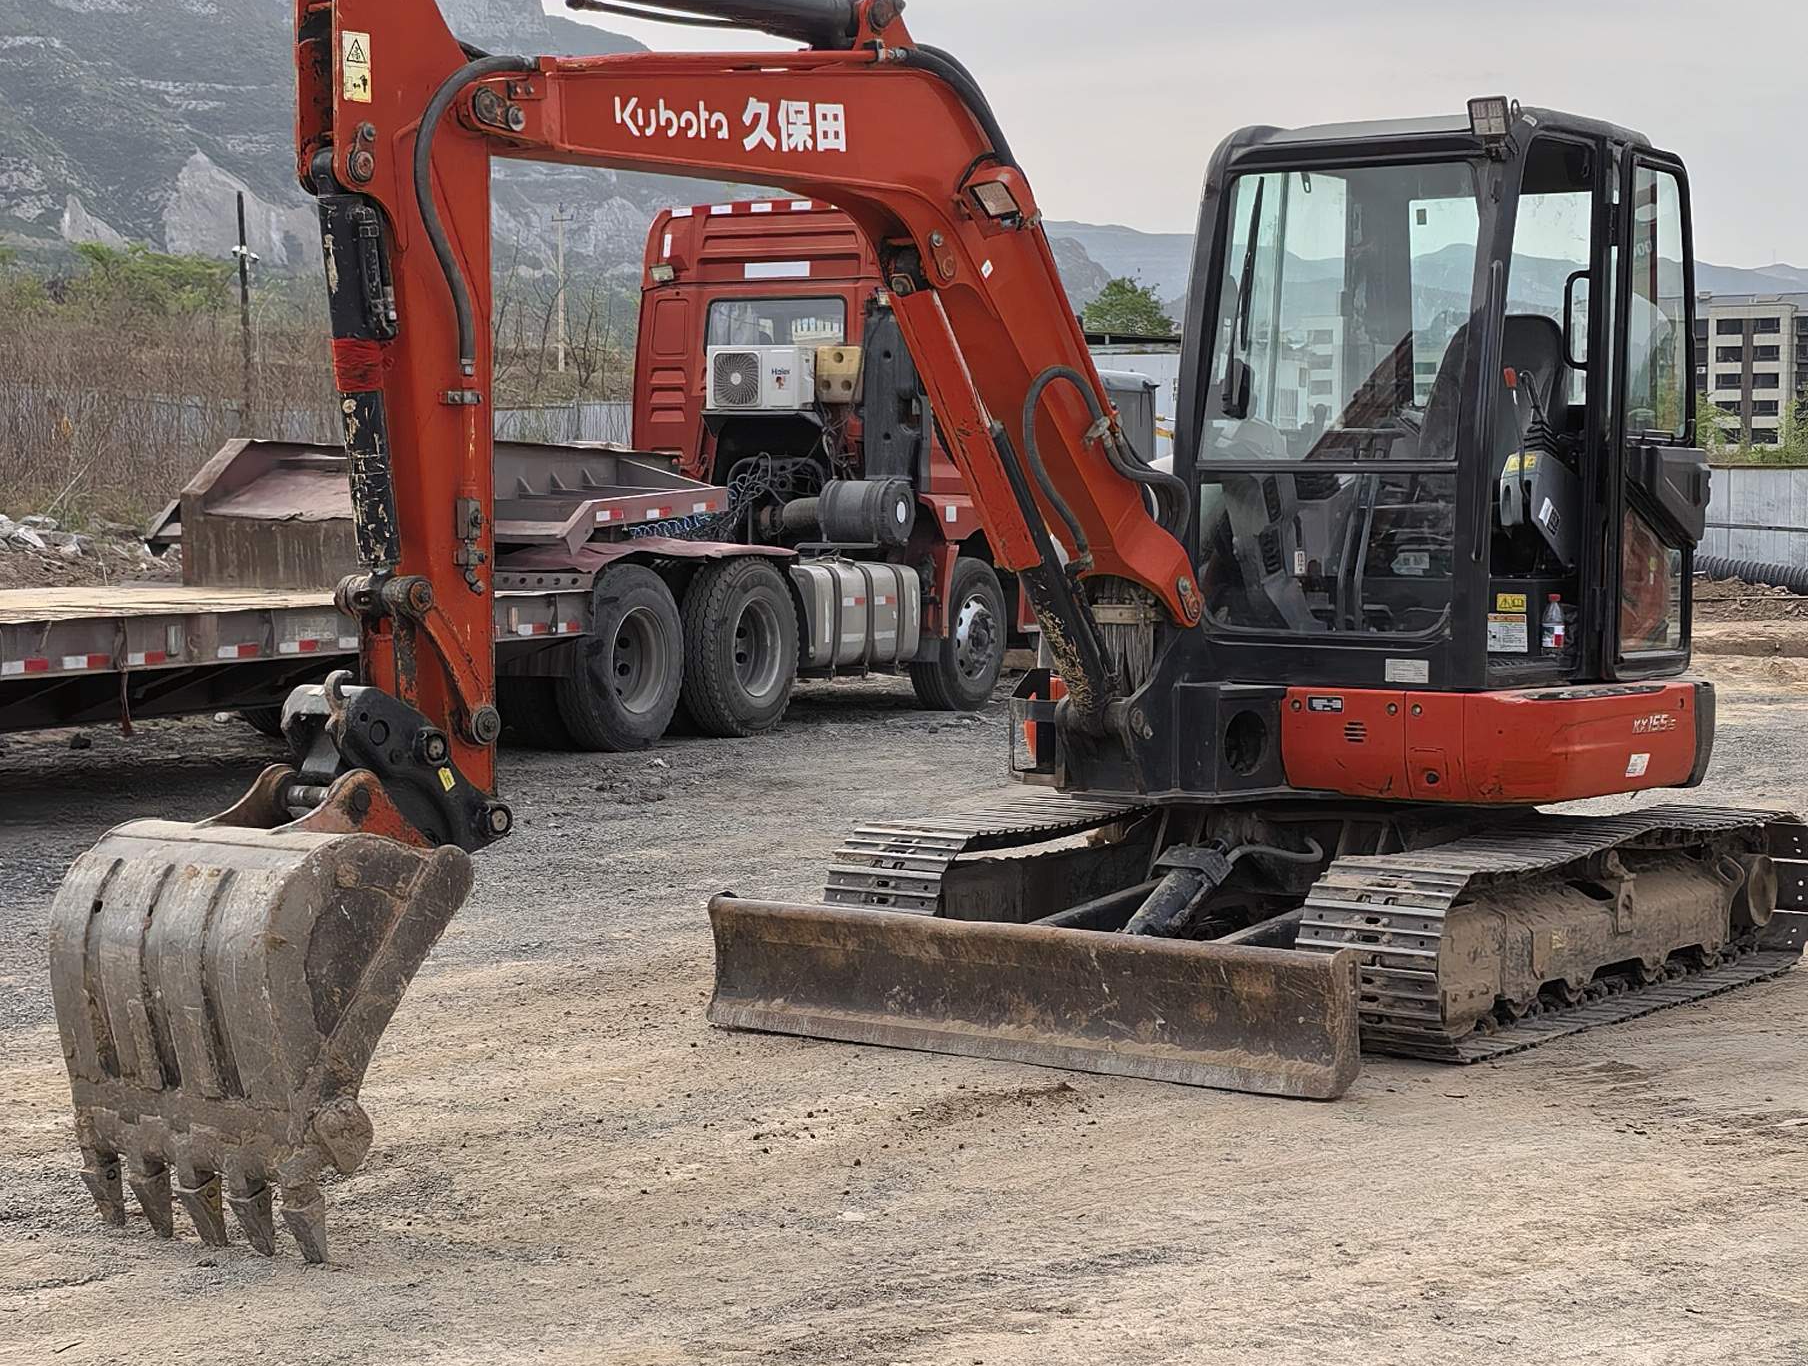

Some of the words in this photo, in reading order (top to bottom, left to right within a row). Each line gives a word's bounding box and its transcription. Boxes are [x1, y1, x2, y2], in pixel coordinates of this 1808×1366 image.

[614, 96, 729, 139] Kubota
[742, 97, 847, 152] 久保田
